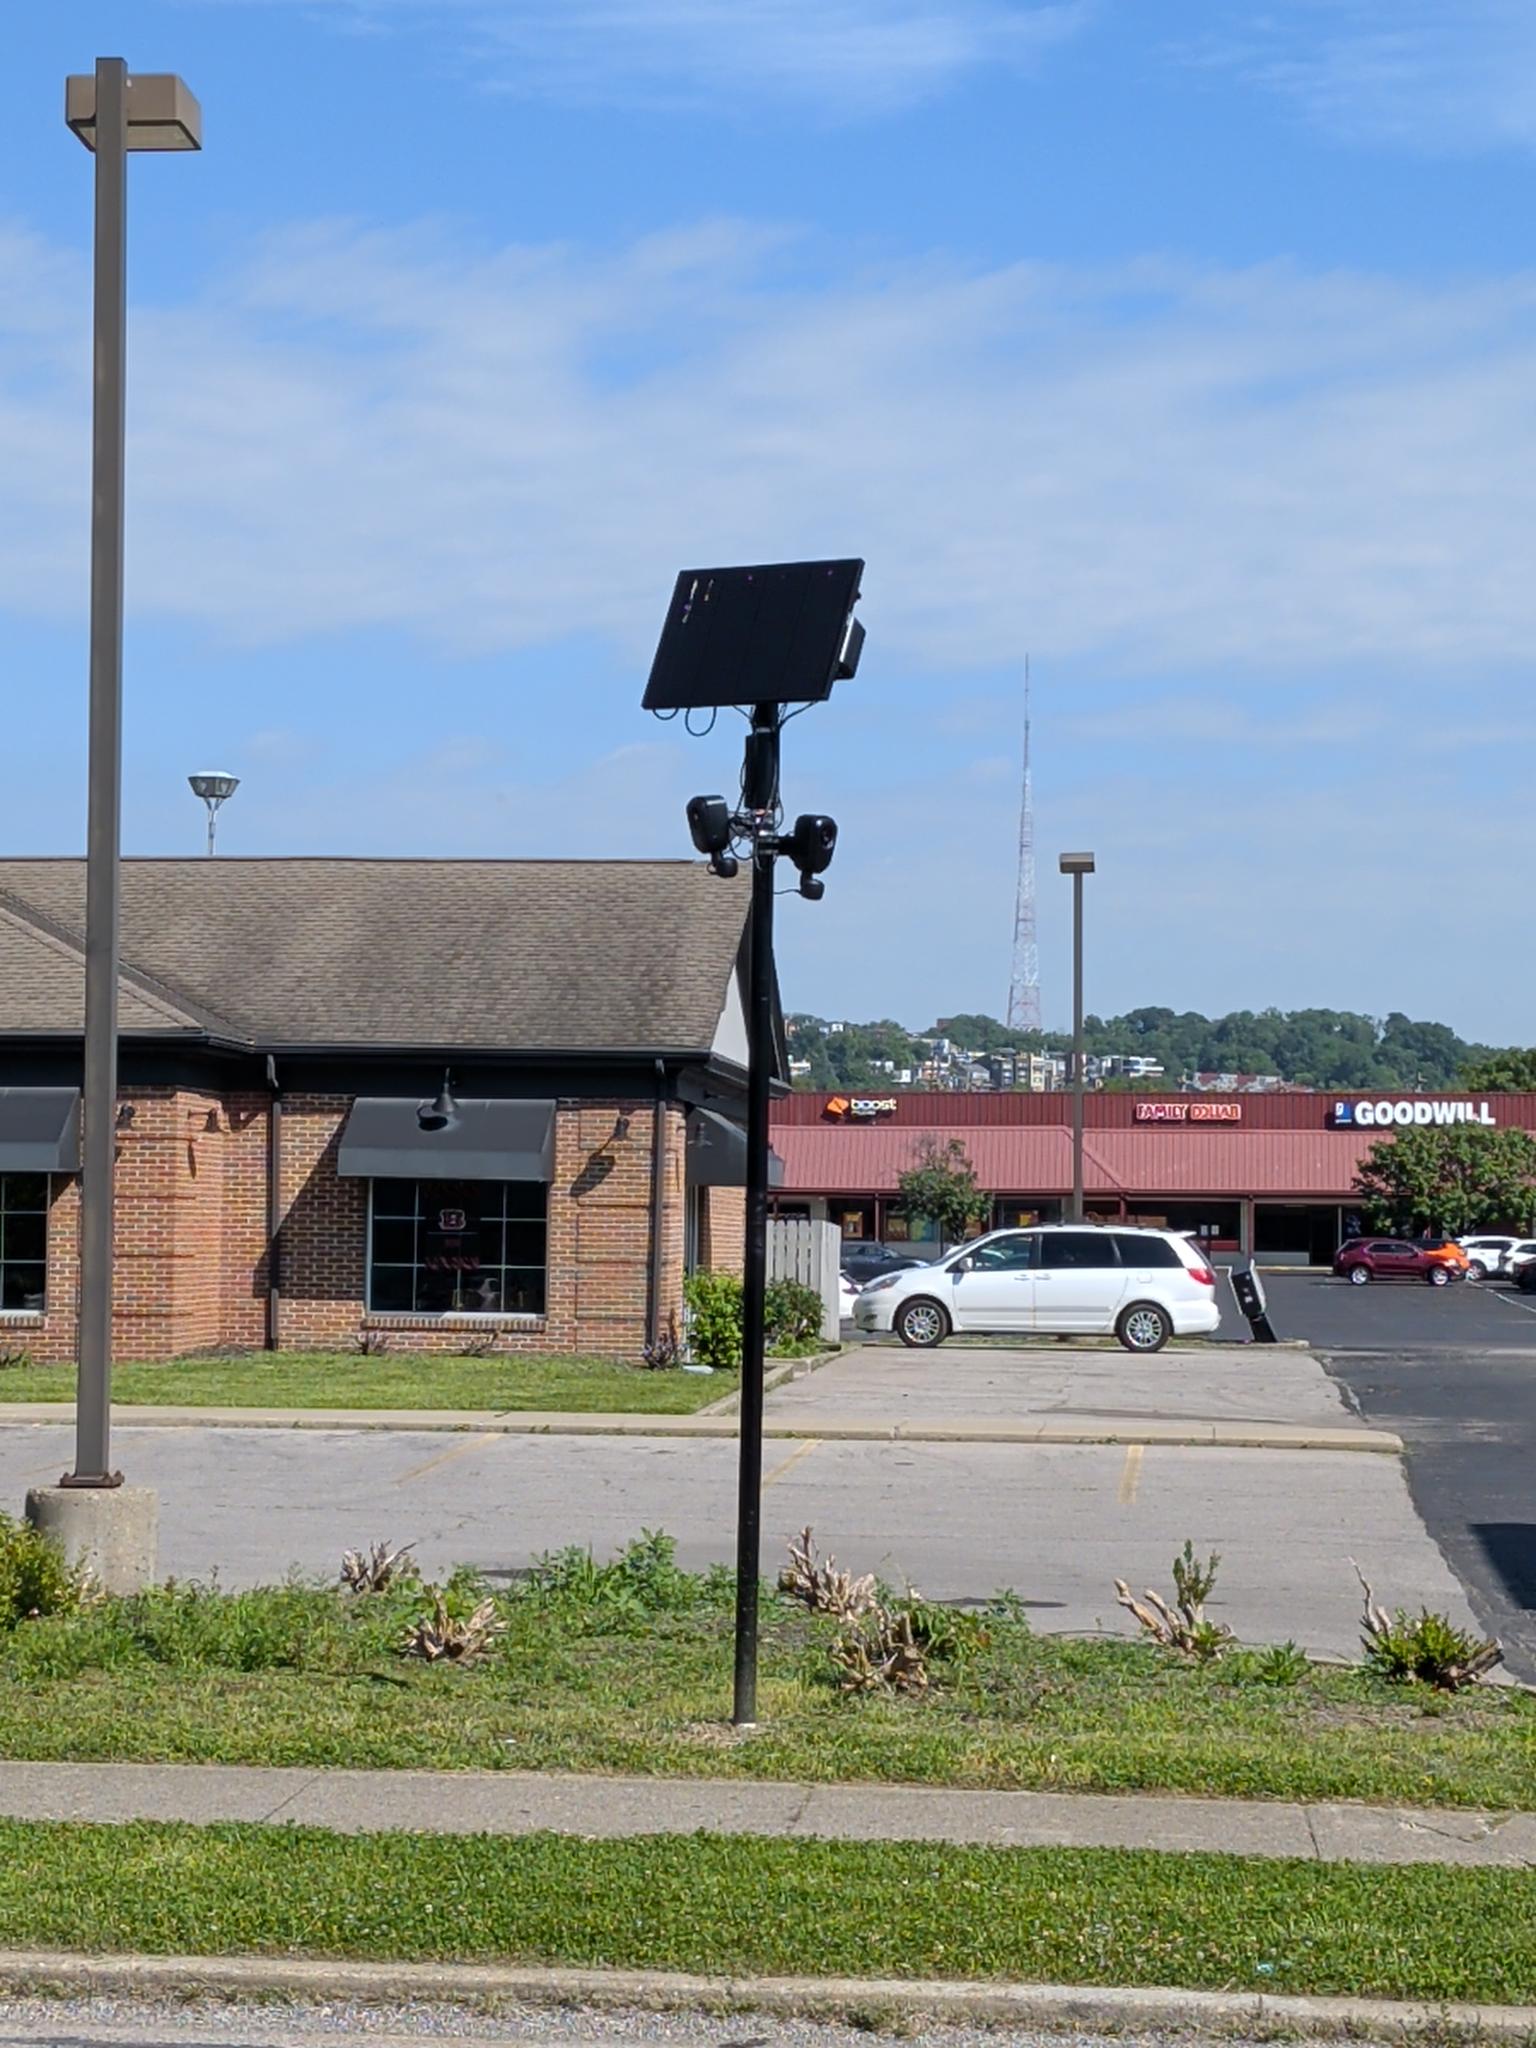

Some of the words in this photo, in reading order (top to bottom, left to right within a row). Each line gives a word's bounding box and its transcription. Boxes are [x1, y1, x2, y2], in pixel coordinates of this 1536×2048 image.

[851, 1098, 897, 1110] boost
[1136, 1103, 1189, 1120] FAMILY
[1190, 1103, 1241, 1120] DOLLAR
[1354, 1101, 1496, 1125] GOODWILL
